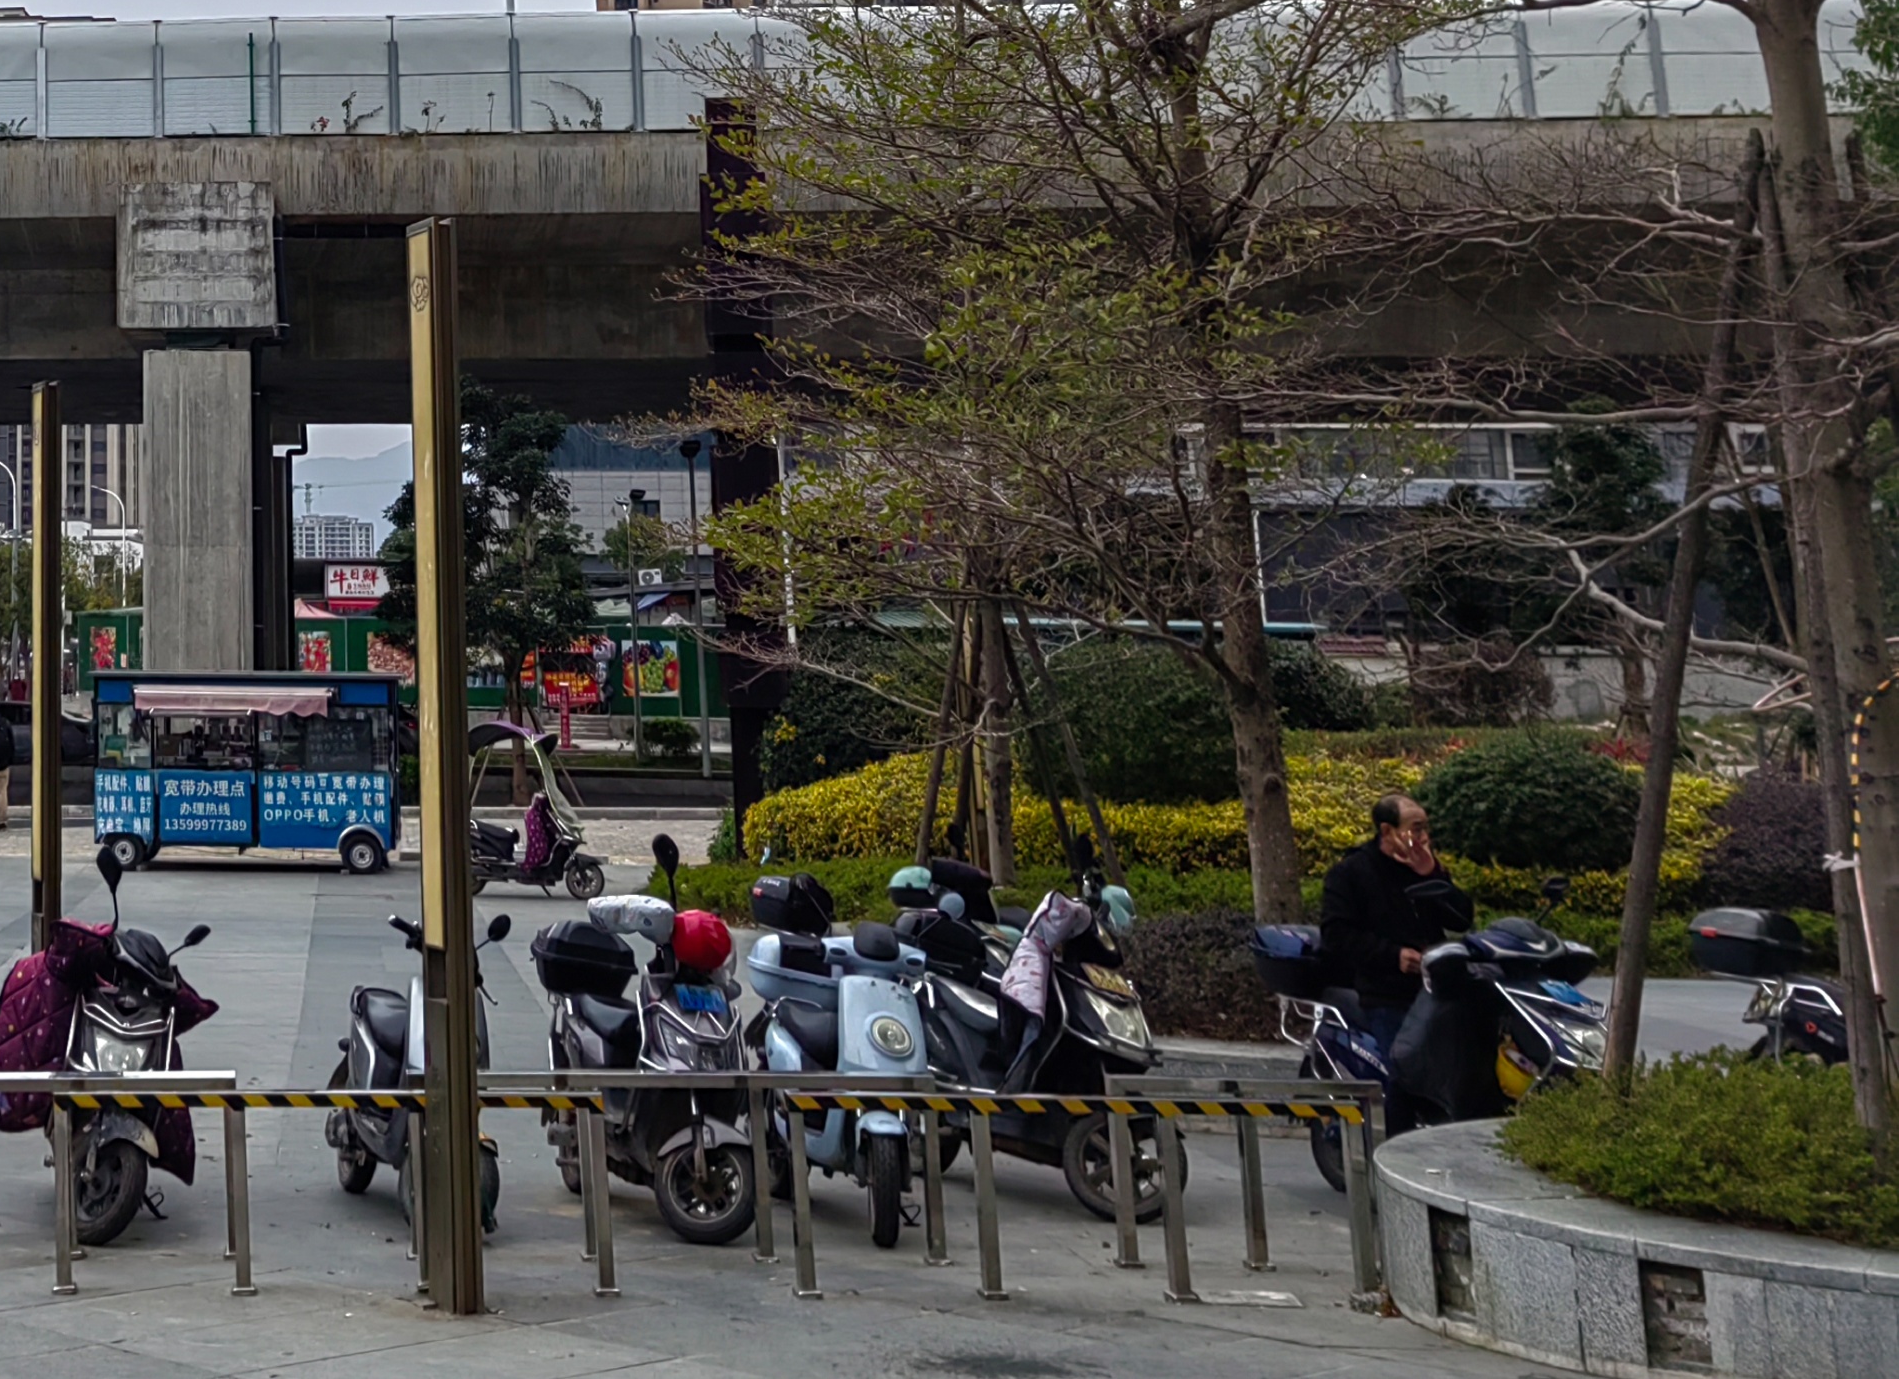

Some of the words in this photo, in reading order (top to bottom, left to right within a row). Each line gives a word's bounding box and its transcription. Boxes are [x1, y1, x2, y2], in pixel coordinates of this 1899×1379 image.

[164, 780, 245, 797] 宽带办理点
[180, 802, 231, 816] 办理热线
[164, 819, 247, 831] 13599977389
